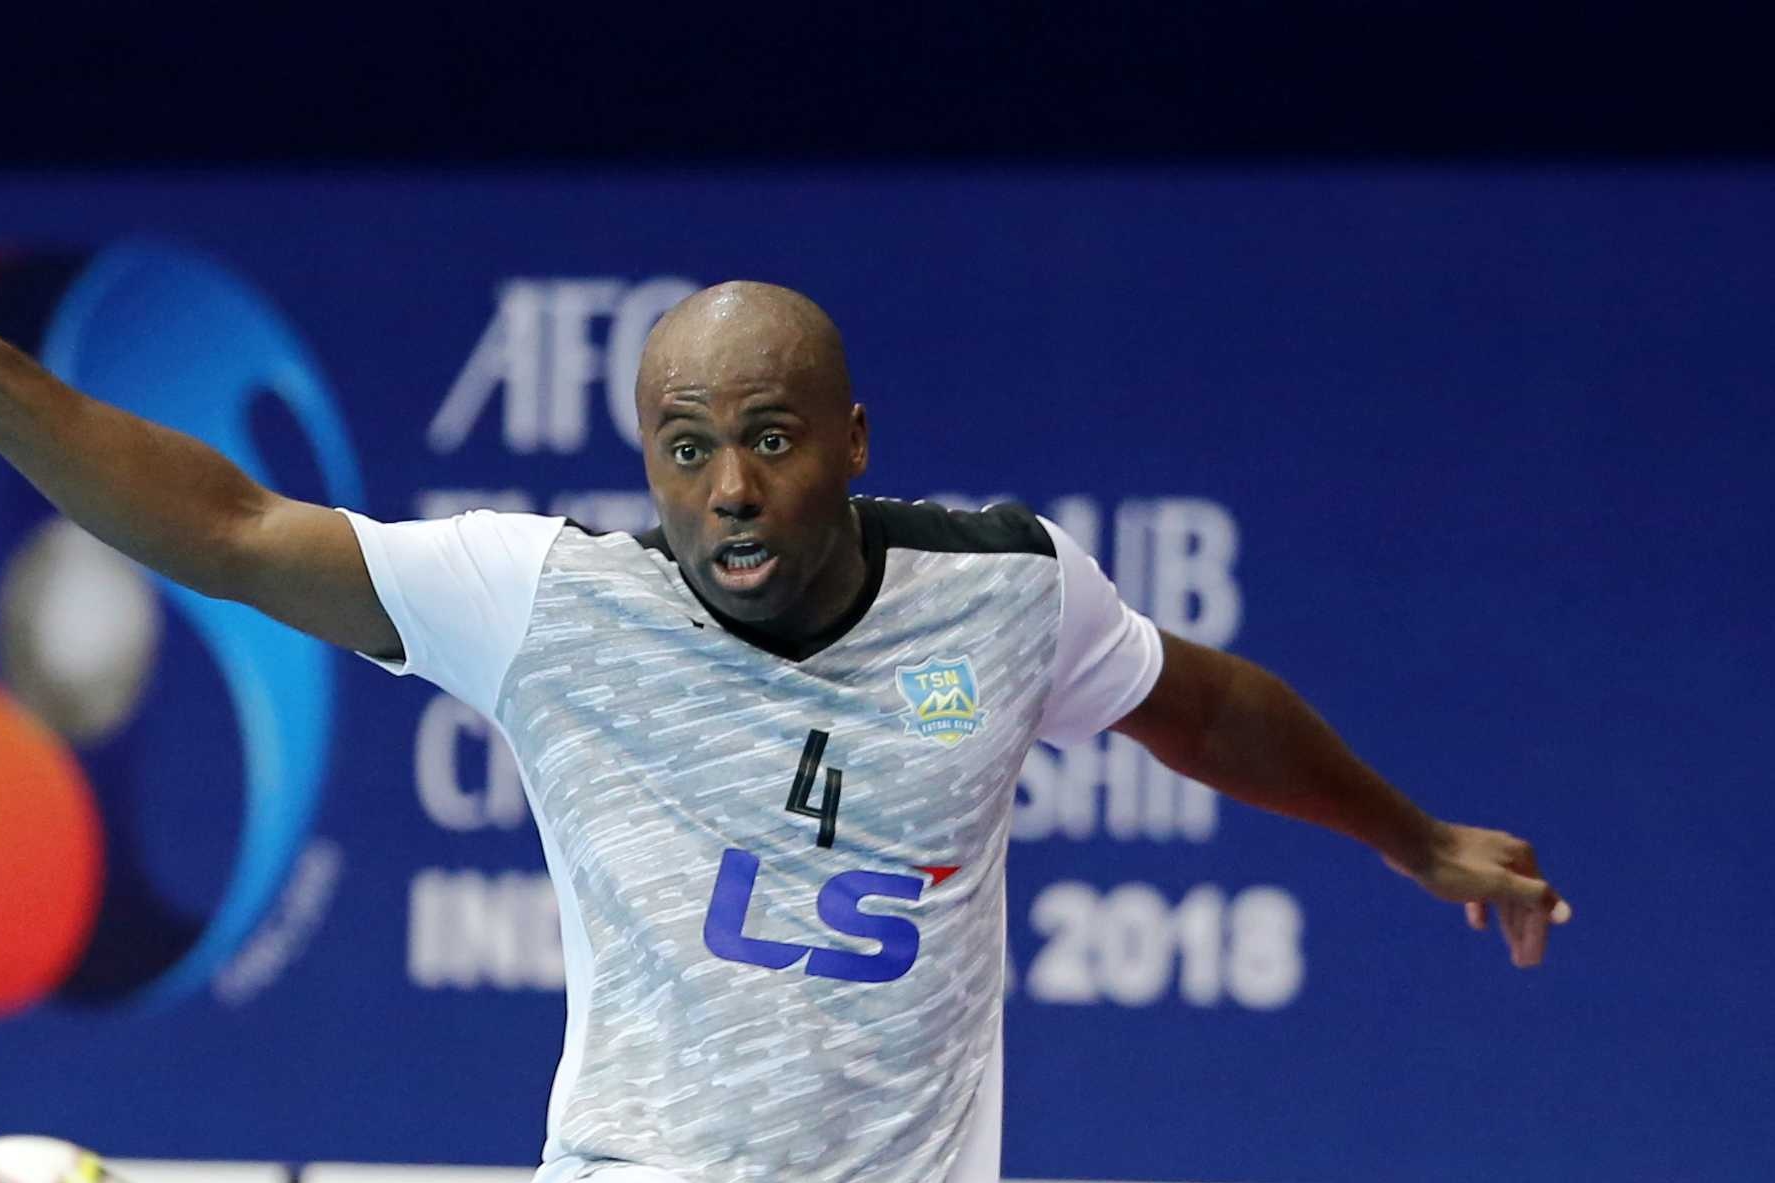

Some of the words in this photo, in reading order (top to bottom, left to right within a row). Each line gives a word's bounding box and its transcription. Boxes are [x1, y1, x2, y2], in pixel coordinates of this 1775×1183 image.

[914, 669, 960, 691] TSN
[785, 728, 842, 849] 4
[703, 847, 924, 983] LS
[1026, 878, 1306, 1011] 2018
